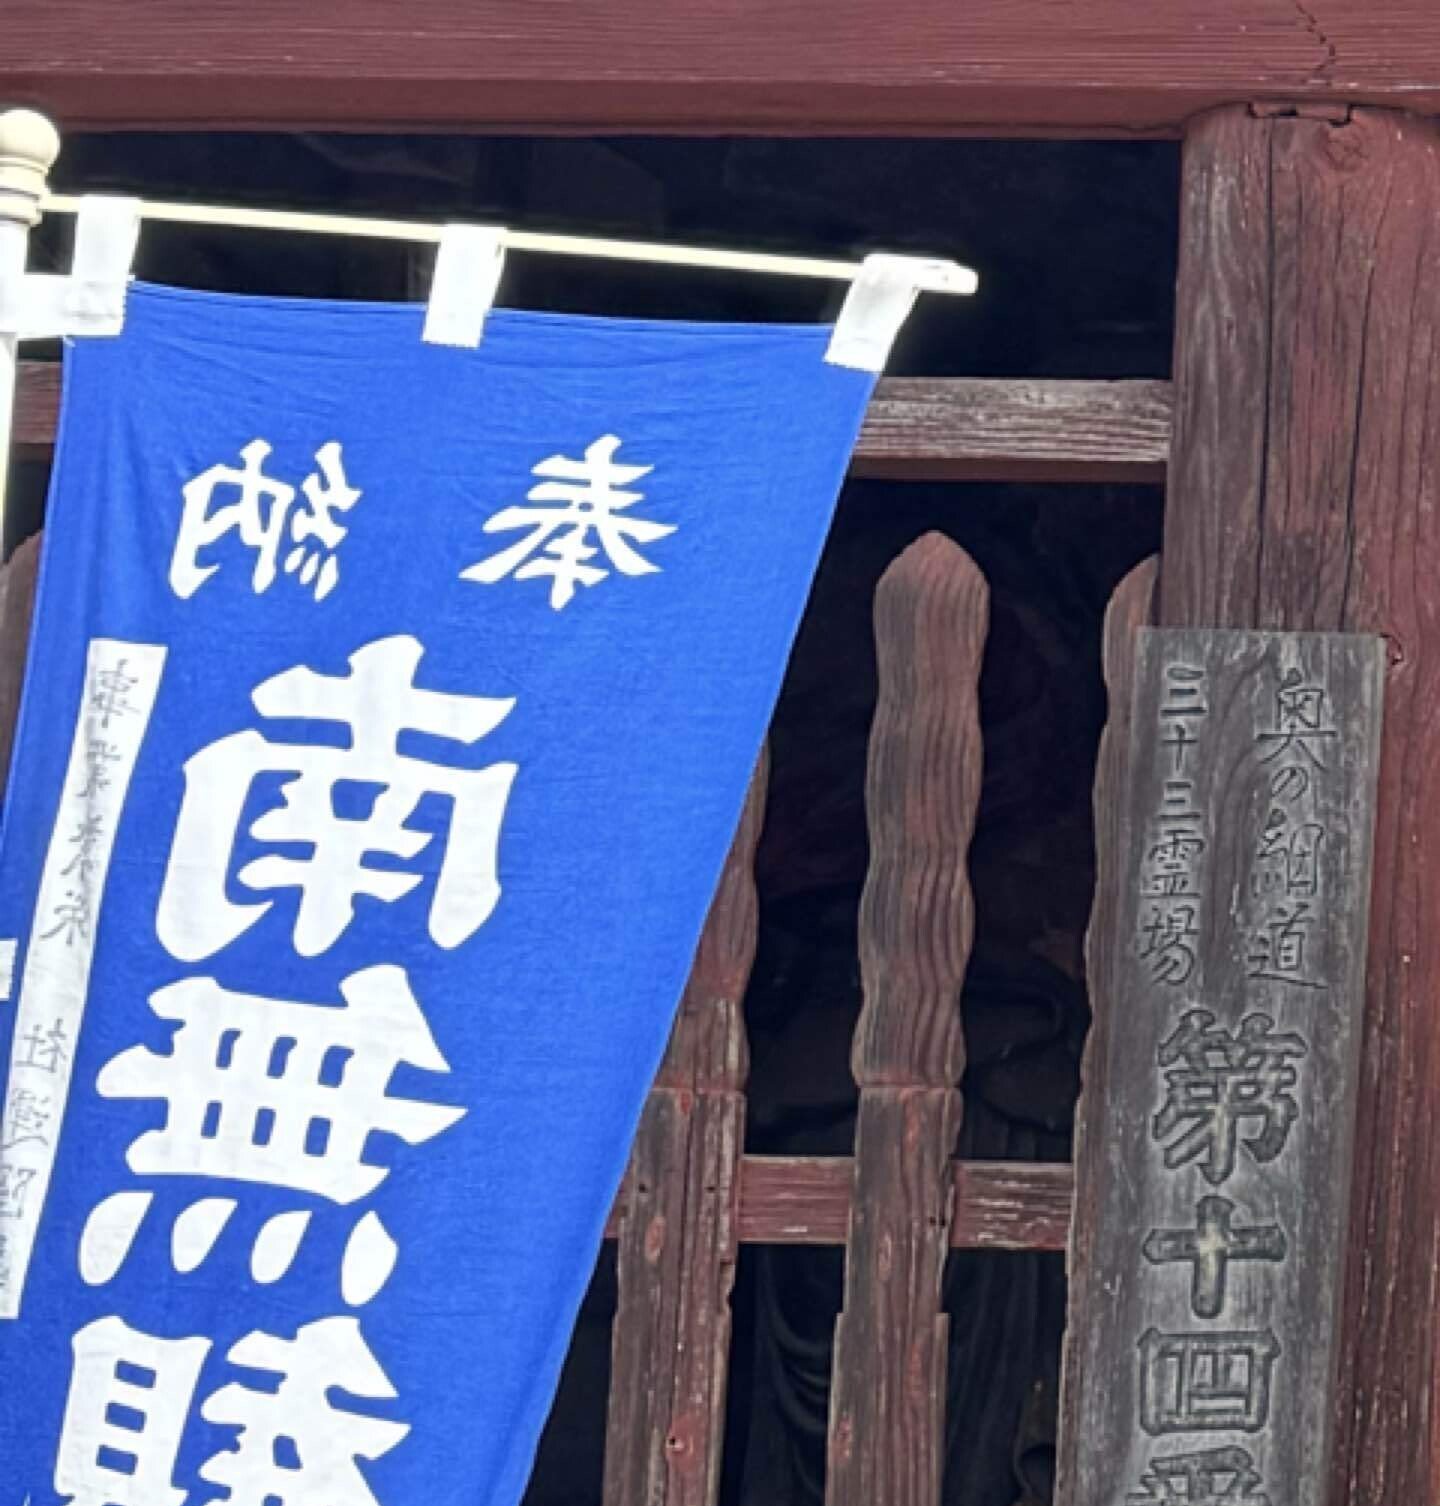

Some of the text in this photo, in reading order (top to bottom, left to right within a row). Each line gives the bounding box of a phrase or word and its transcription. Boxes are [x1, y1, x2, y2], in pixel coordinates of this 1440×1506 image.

[1139, 664, 1208, 987] 三十三霊場
[1248, 666, 1337, 989] 奥の細道
